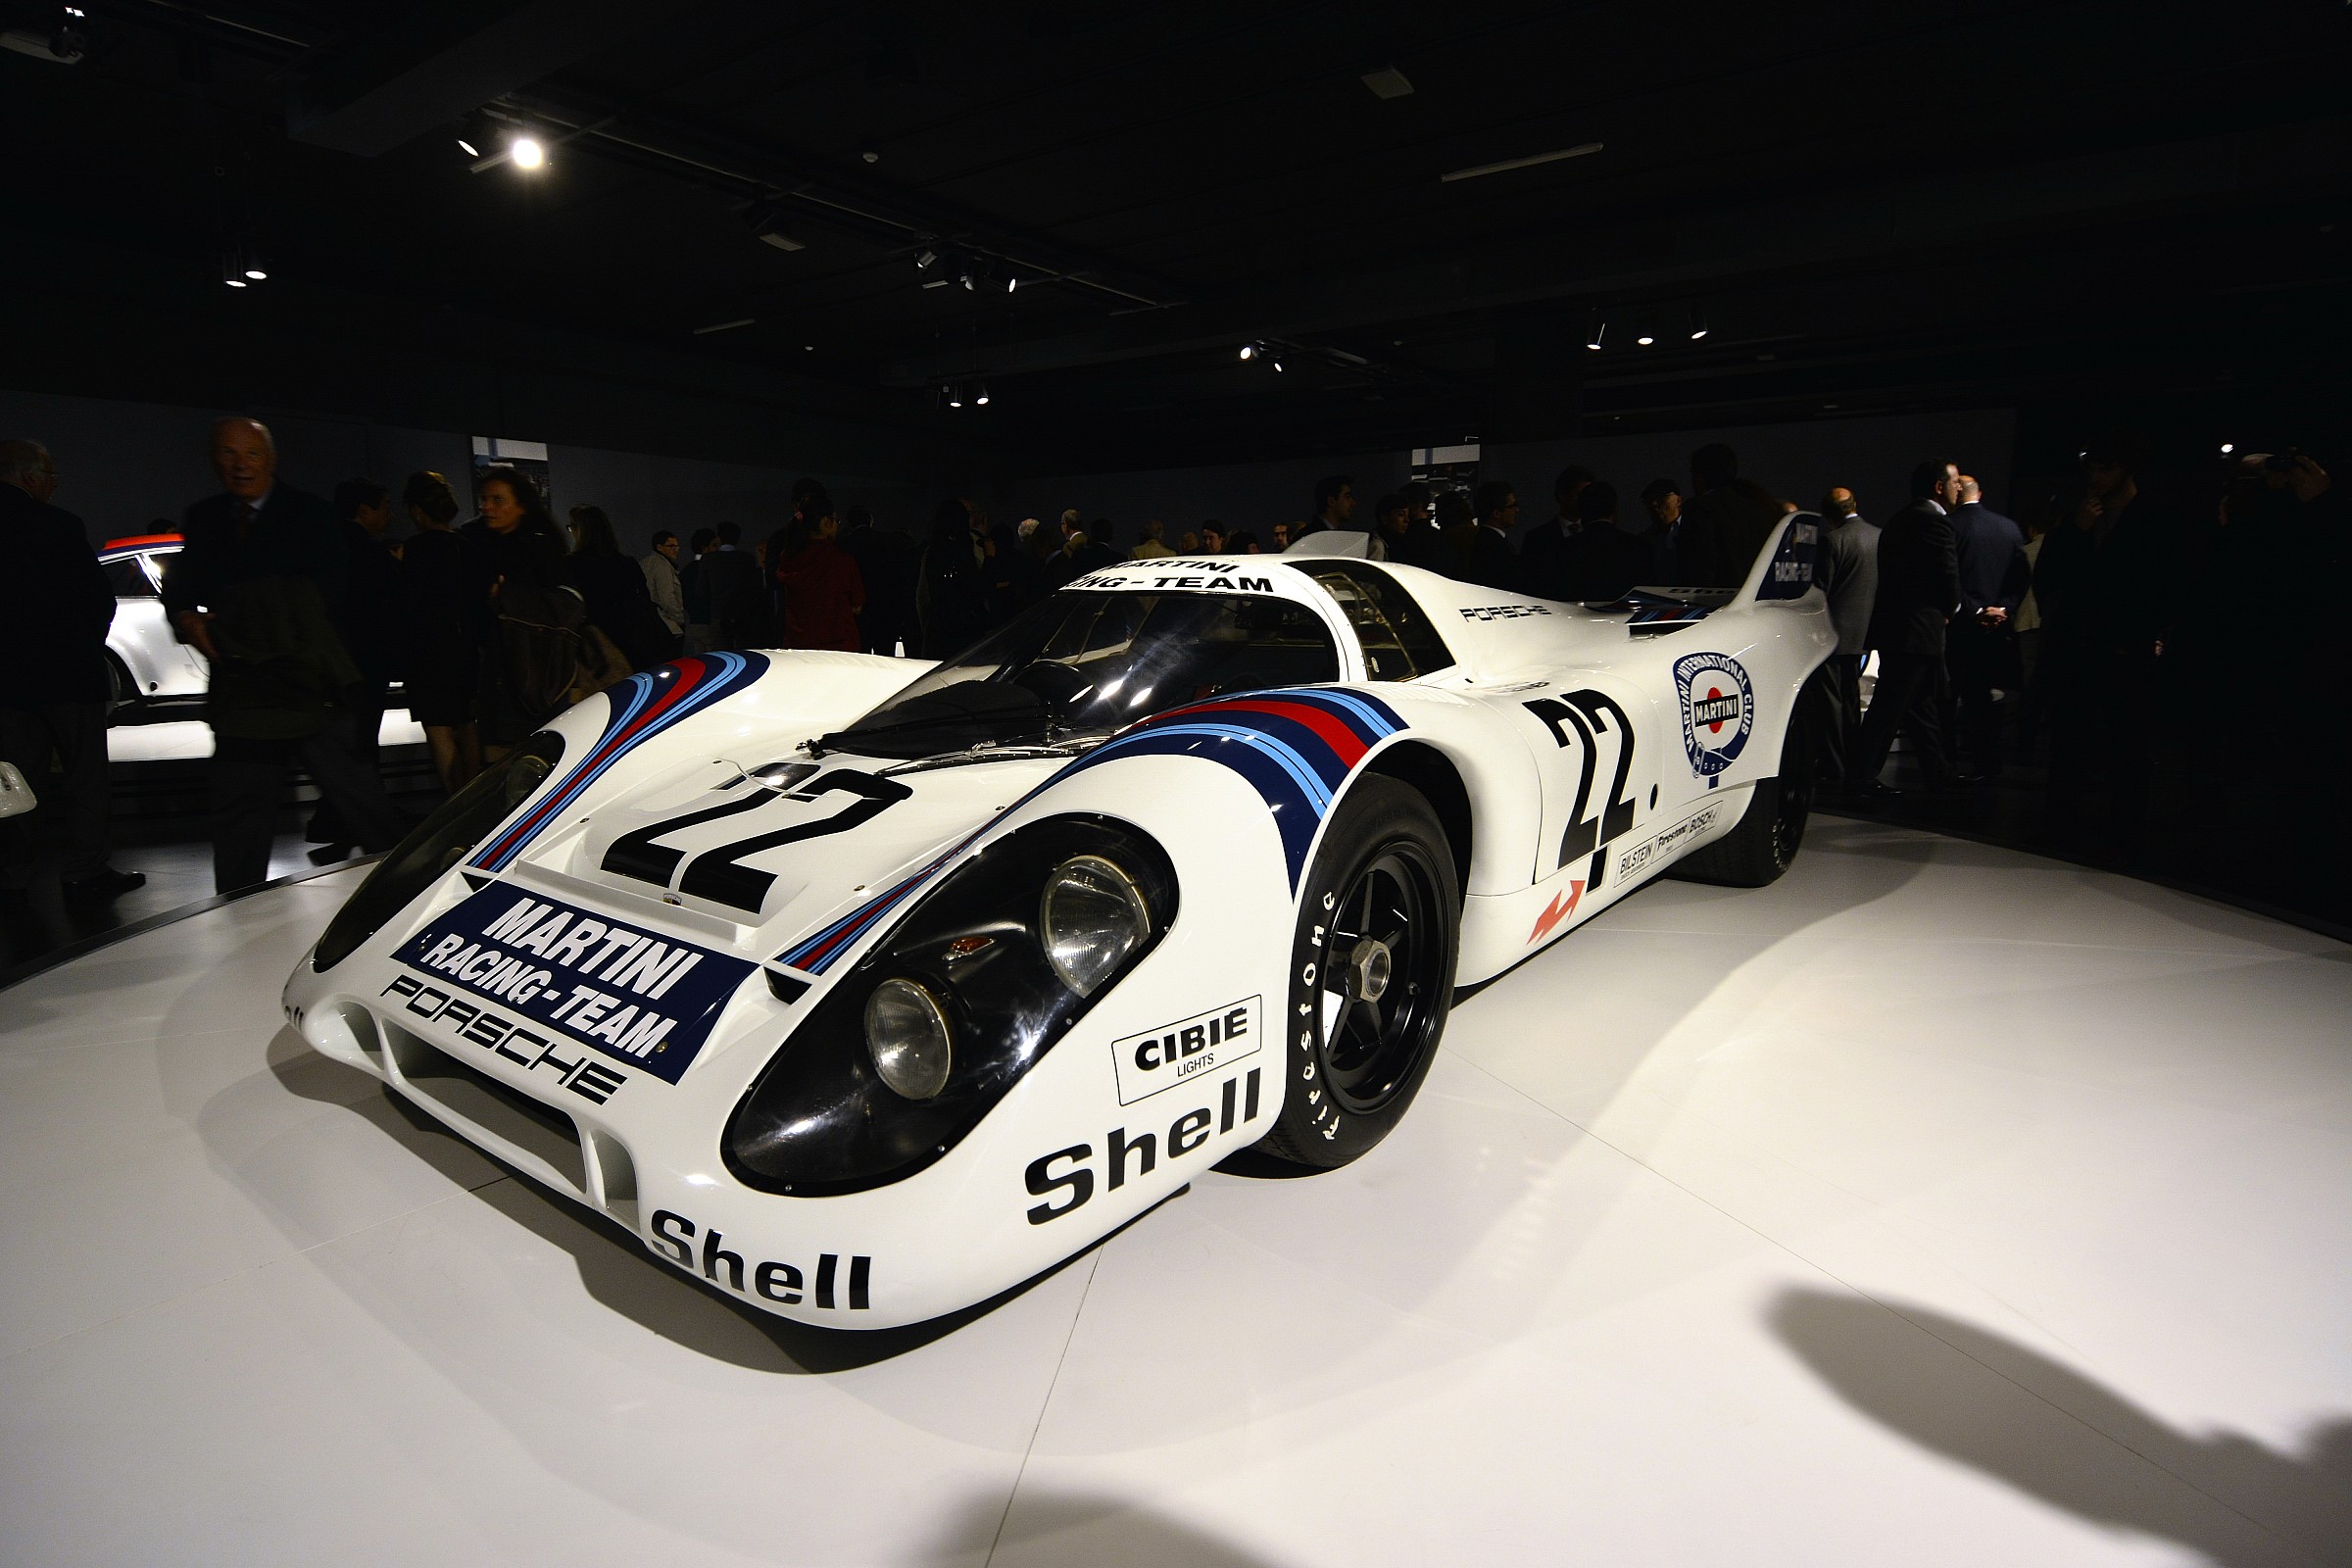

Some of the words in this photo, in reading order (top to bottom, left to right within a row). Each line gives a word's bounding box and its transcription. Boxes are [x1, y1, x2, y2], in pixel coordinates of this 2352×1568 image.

[1458, 605, 1552, 622] PORSCHE
[1677, 655, 1748, 692] INTERNATIONAL
[1677, 679, 1695, 754] MARTINI
[1695, 698, 1738, 723] MARTINI
[1740, 693, 1753, 736] CLUB
[599, 761, 913, 914] 22
[1619, 842, 1653, 874] BILSTEIN
[481, 897, 704, 1001] MARTINI
[379, 973, 627, 1106] PORSCHE
[1177, 1053, 1214, 1077] LIGHTS
[1024, 1066, 1261, 1226] Shell
[651, 1208, 871, 1310] Shell
